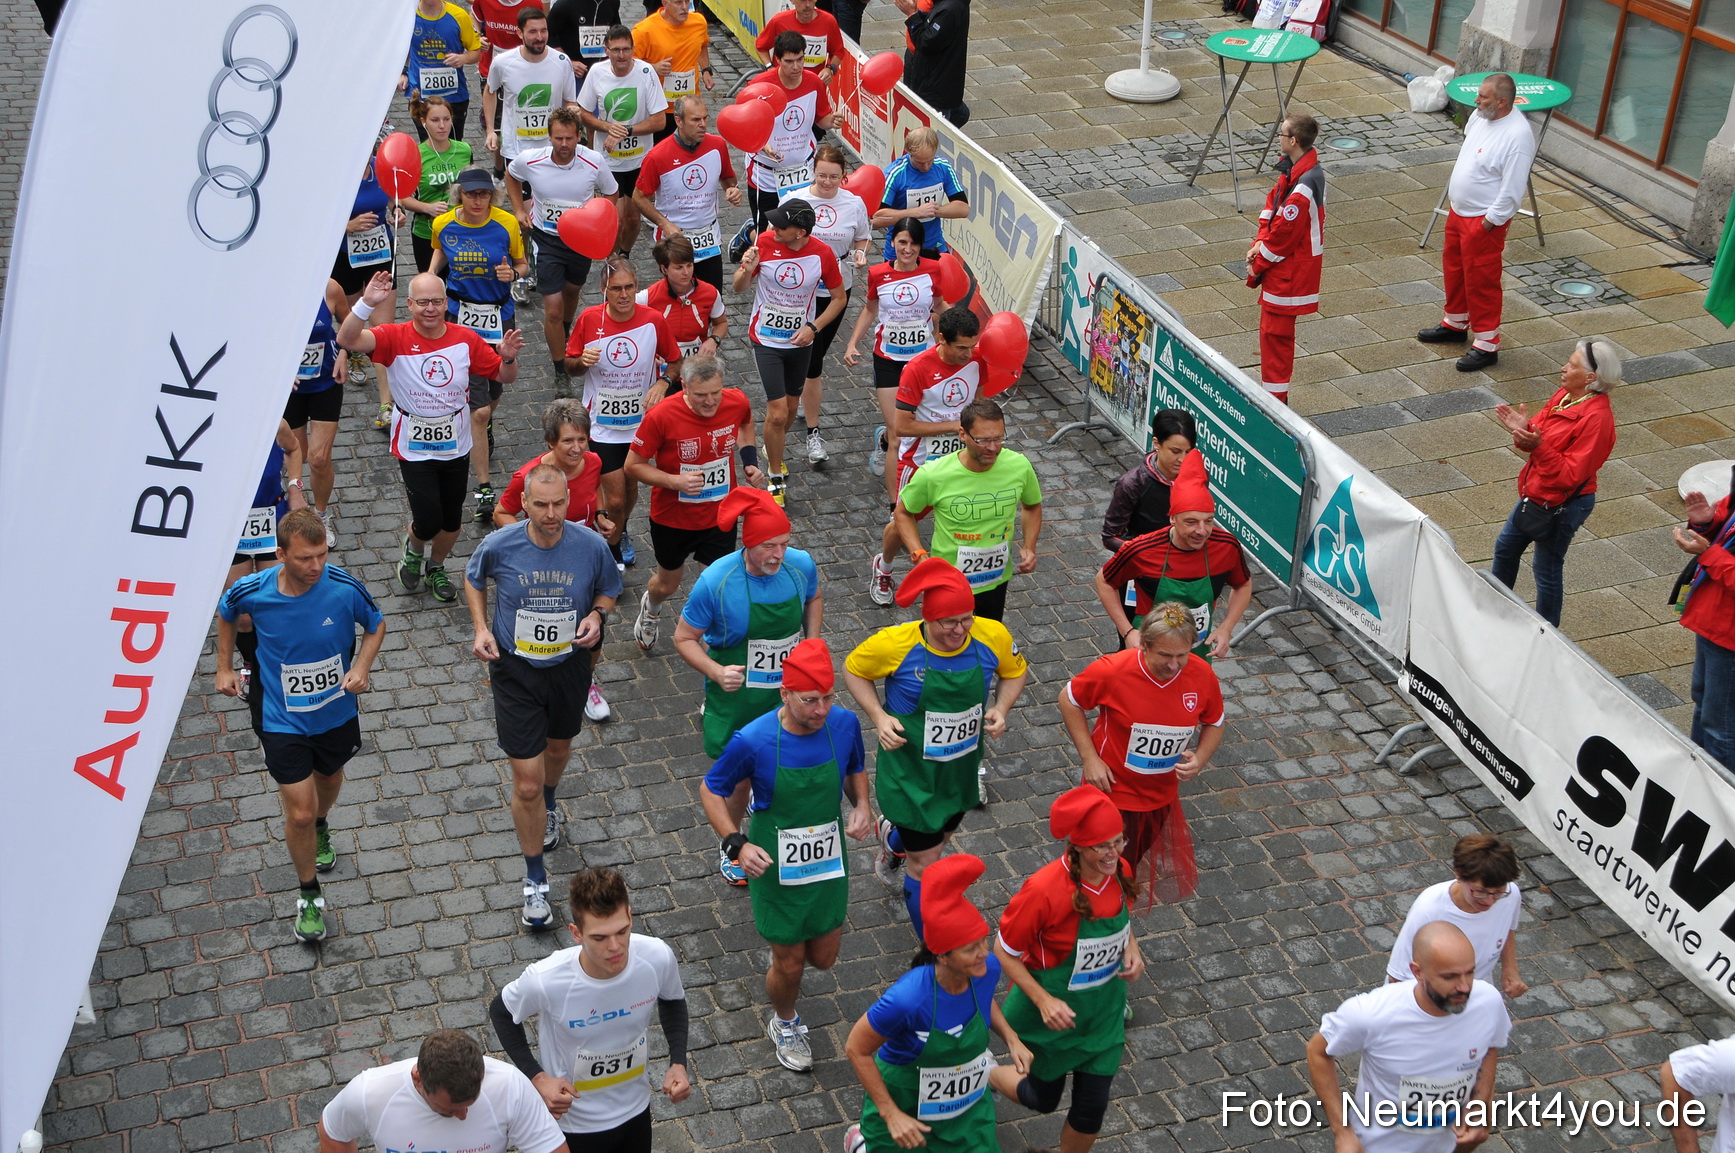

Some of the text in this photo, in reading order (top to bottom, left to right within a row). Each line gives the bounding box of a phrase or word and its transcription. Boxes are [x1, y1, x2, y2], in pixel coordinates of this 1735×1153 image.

[424, 75, 455, 89] 2808
[674, 79, 689, 91] 34
[523, 114, 546, 128] 137
[778, 168, 810, 187] 2172
[352, 235, 386, 253] 2326
[462, 311, 498, 329] 2279
[766, 313, 802, 330] 2858
[889, 330, 926, 345] 2846
[1178, 358, 1247, 427] Event-Leit-Systeme
[601, 399, 640, 415] 2835
[130, 331, 229, 539] BKK
[413, 424, 453, 441] 2863
[241, 518, 272, 537] 754
[953, 532, 982, 541] MERZ
[1218, 504, 1260, 551] 09181 6352
[962, 554, 1004, 574] 2245
[518, 570, 575, 587] EL PALMAR
[1305, 573, 1382, 636] Gebäude Service GmbH
[534, 624, 559, 642] 66
[528, 644, 561, 654] Andreas
[73, 577, 176, 802] Audi
[288, 668, 340, 694] 2595
[308, 694, 326, 705] Dirk
[931, 718, 978, 744] 2789
[1133, 727, 1154, 735] PARTL
[1134, 736, 1187, 757] 2087
[1456, 719, 1520, 788] die verbinden
[1147, 760, 1166, 768] Reto
[785, 836, 836, 864] 2067
[1552, 808, 1703, 955] stadtwerke
[590, 1053, 634, 1077] 631
[921, 1071, 947, 1079] PARTL
[926, 1069, 985, 1101] 2407
